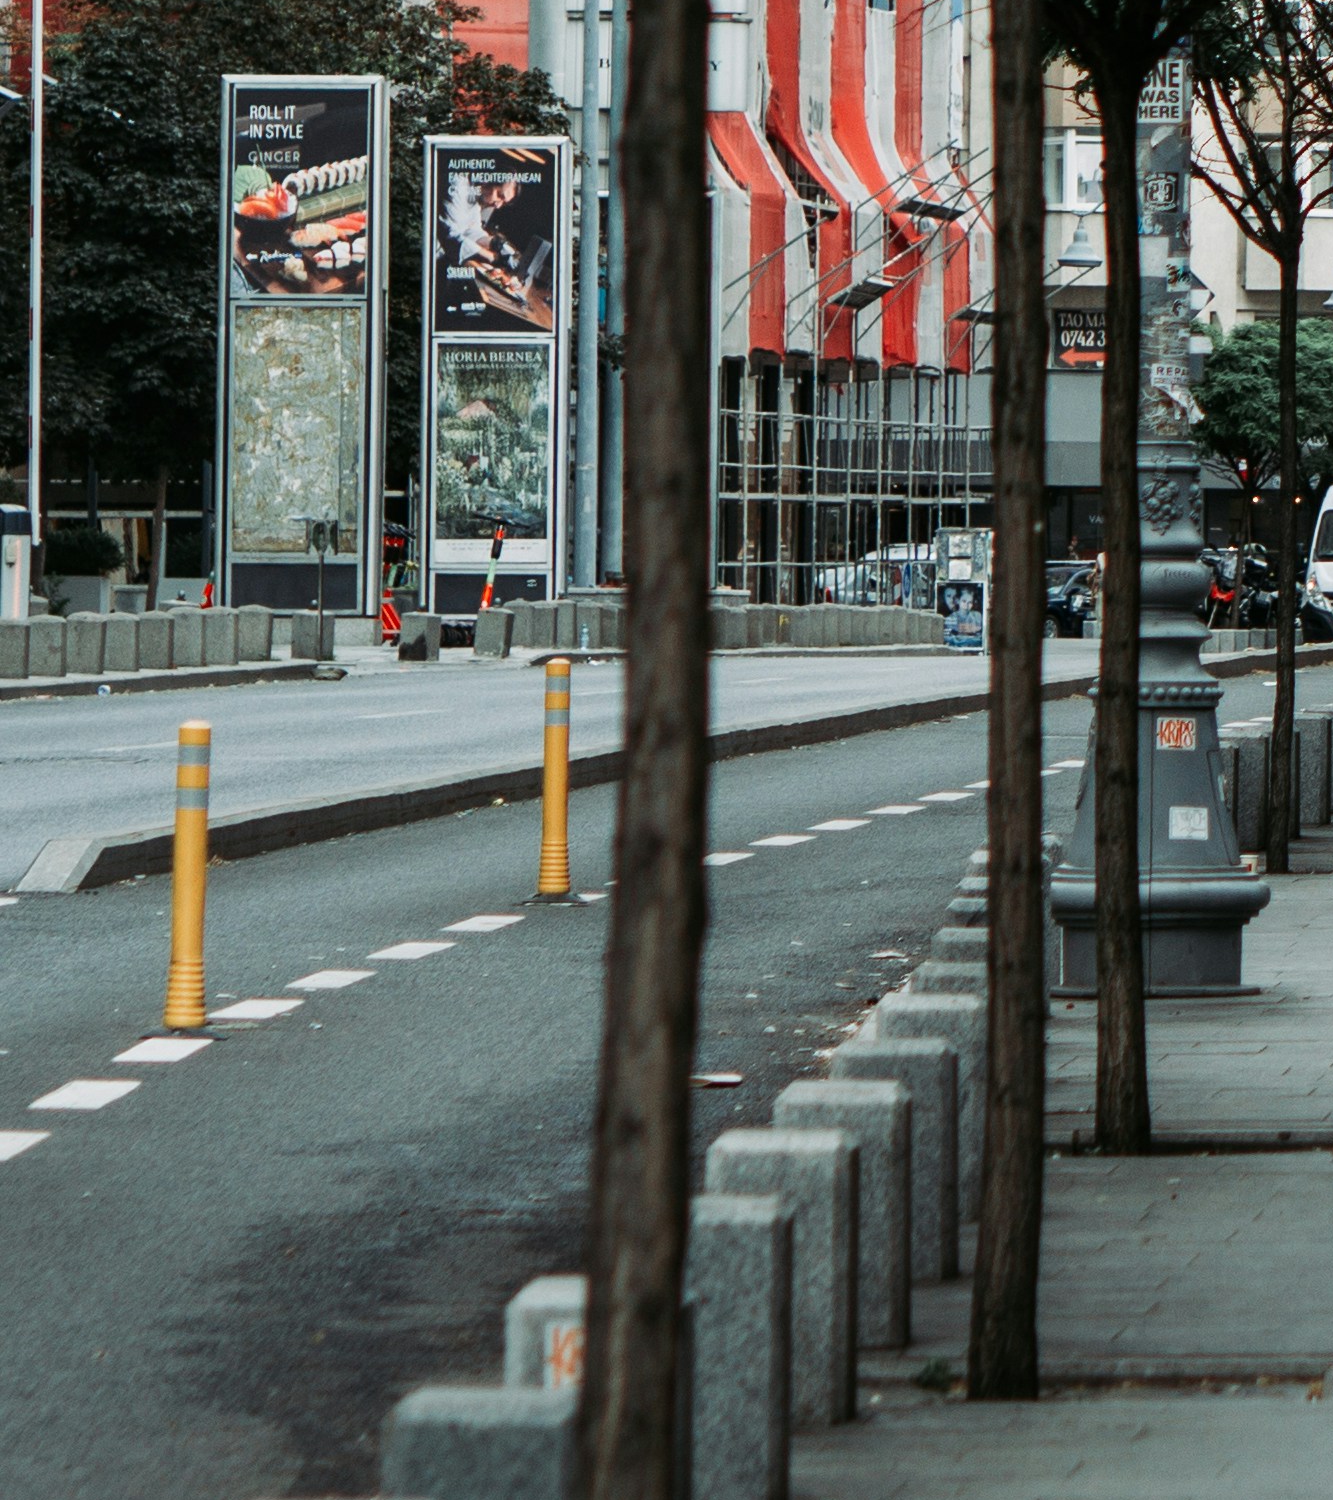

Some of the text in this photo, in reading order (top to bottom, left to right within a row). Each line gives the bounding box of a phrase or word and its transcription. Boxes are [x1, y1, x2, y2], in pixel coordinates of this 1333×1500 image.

[1139, 90, 1180, 103] WAS
[250, 105, 296, 119] ROLL IT
[1138, 105, 1180, 118] HERE
[250, 124, 304, 139] IN STYLE
[248, 150, 300, 163] GINGER
[448, 159, 496, 170] AUTHENTIC
[471, 172, 542, 183] MEDITERRANEAN
[1059, 313, 1083, 327] TAO
[1061, 330, 1095, 347] 0742
[446, 351, 542, 363] HORIA BERNEA
